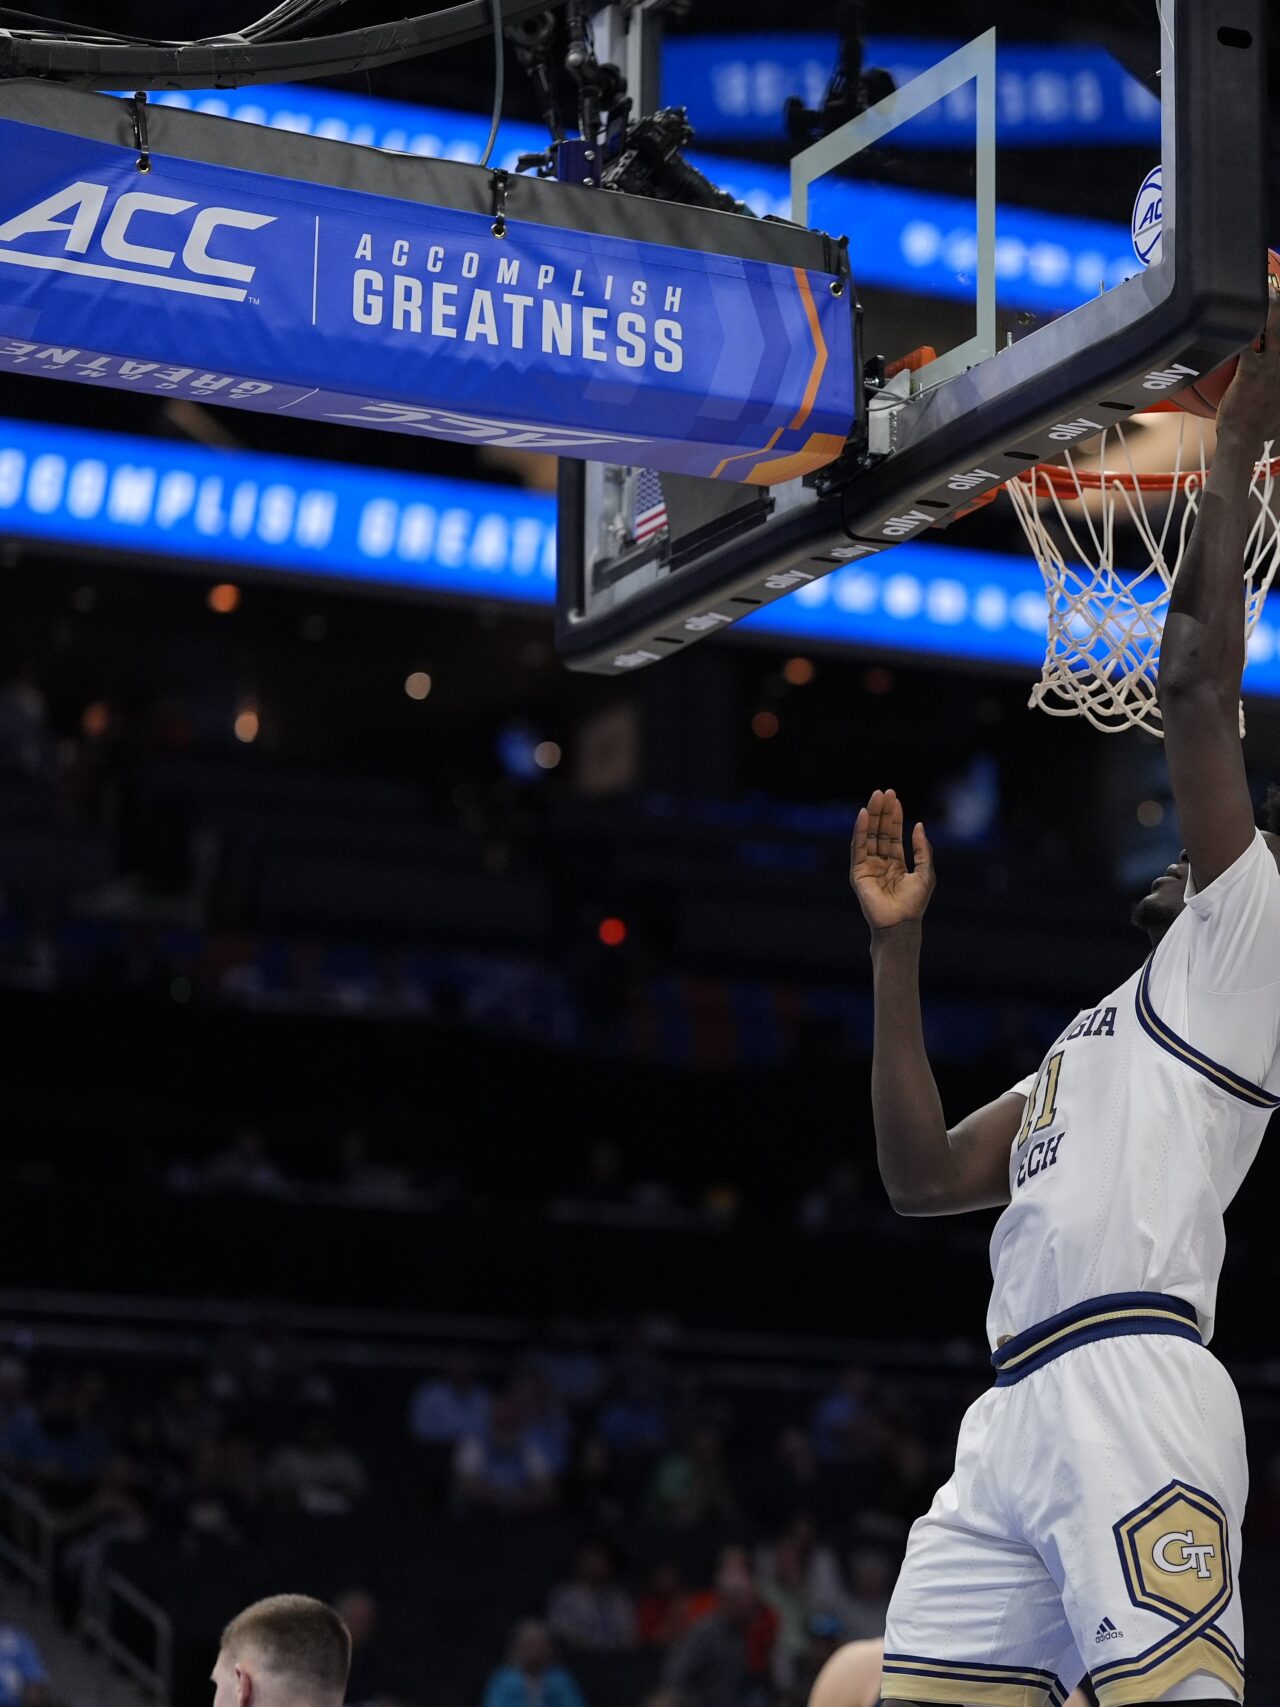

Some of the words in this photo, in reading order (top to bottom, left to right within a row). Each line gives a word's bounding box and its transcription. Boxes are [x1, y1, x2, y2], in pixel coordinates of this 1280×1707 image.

[0, 181, 279, 284] ACC
[354, 233, 682, 313] ACCOMPLISH
[352, 268, 684, 373] GREATNESS
[1142, 363, 1200, 390] ally
[1048, 418, 1104, 441] ally
[948, 468, 1000, 490] ally
[882, 510, 935, 536] ally
[765, 570, 814, 589] ally
[1151, 1529, 1216, 1579] GT
[1095, 1630, 1124, 1643] adidas
